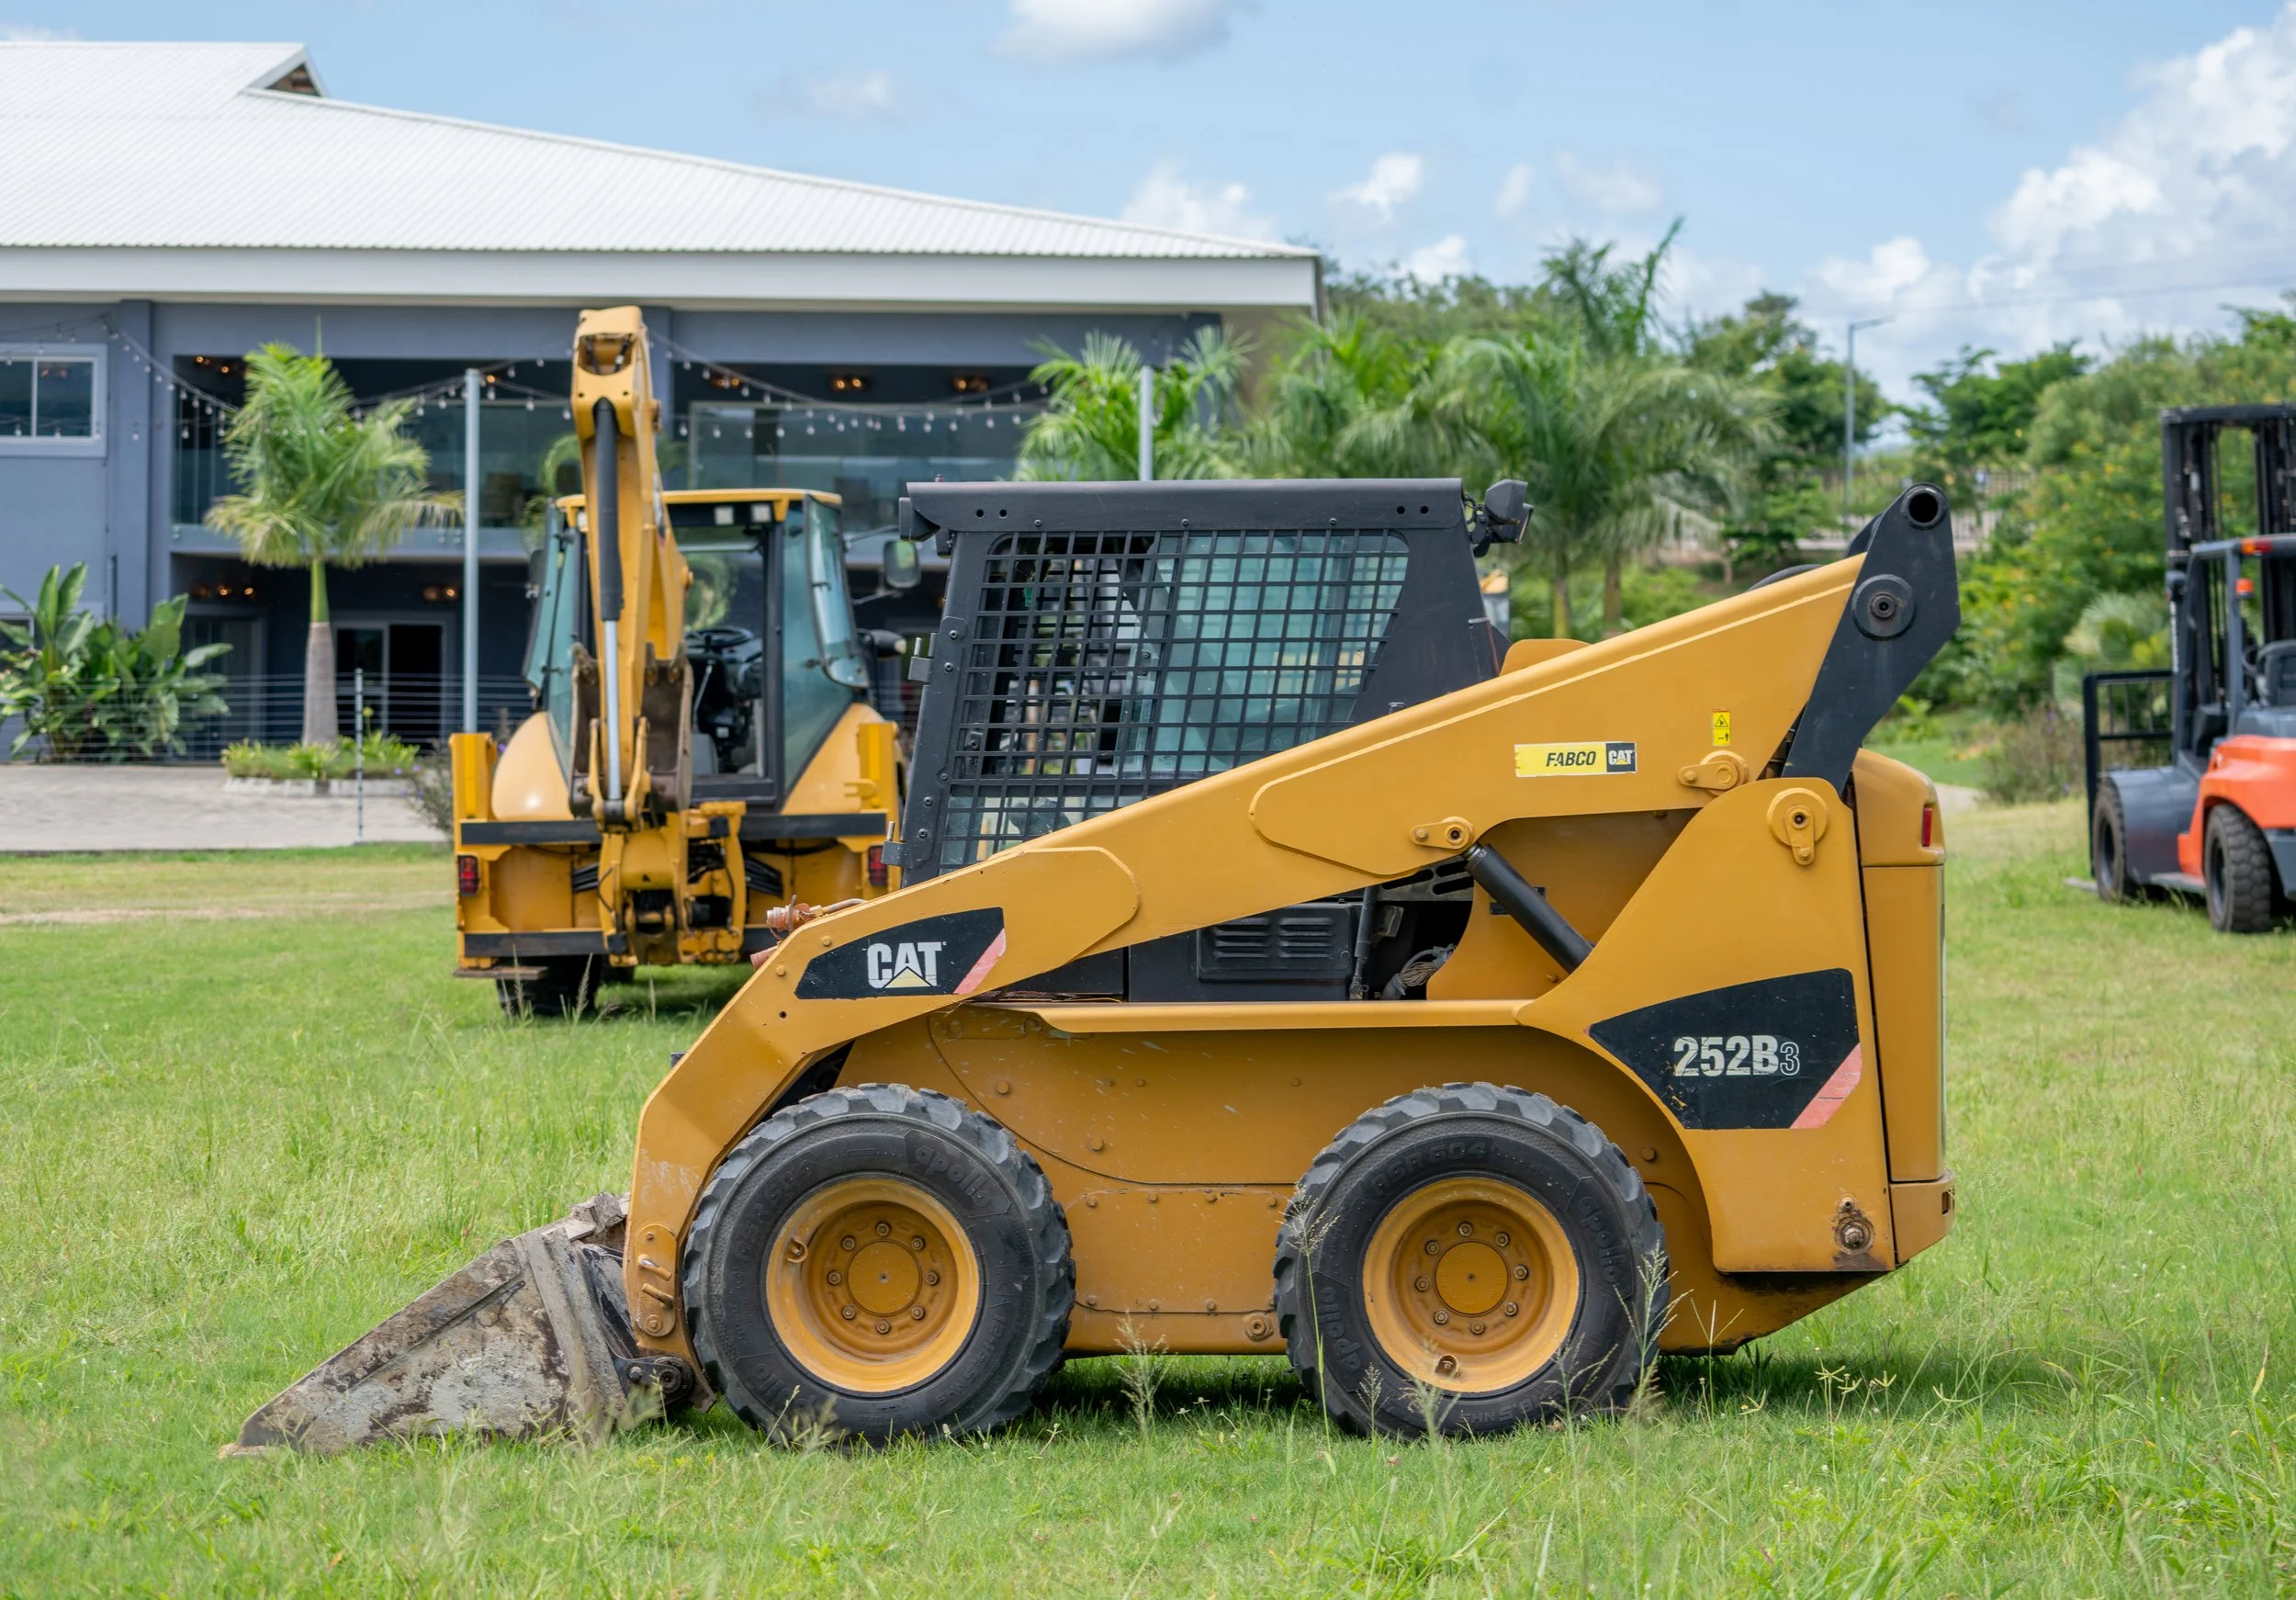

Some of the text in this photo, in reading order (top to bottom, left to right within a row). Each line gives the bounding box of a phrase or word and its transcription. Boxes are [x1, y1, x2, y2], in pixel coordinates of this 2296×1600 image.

[1546, 749, 1635, 767] FABCO CAT
[867, 941, 942, 989] CAT
[915, 1144, 993, 1209] apollo
[1426, 1141, 1487, 1165] 604
[1574, 1194, 1626, 1283] apollo
[1315, 1287, 1364, 1373] apollo
